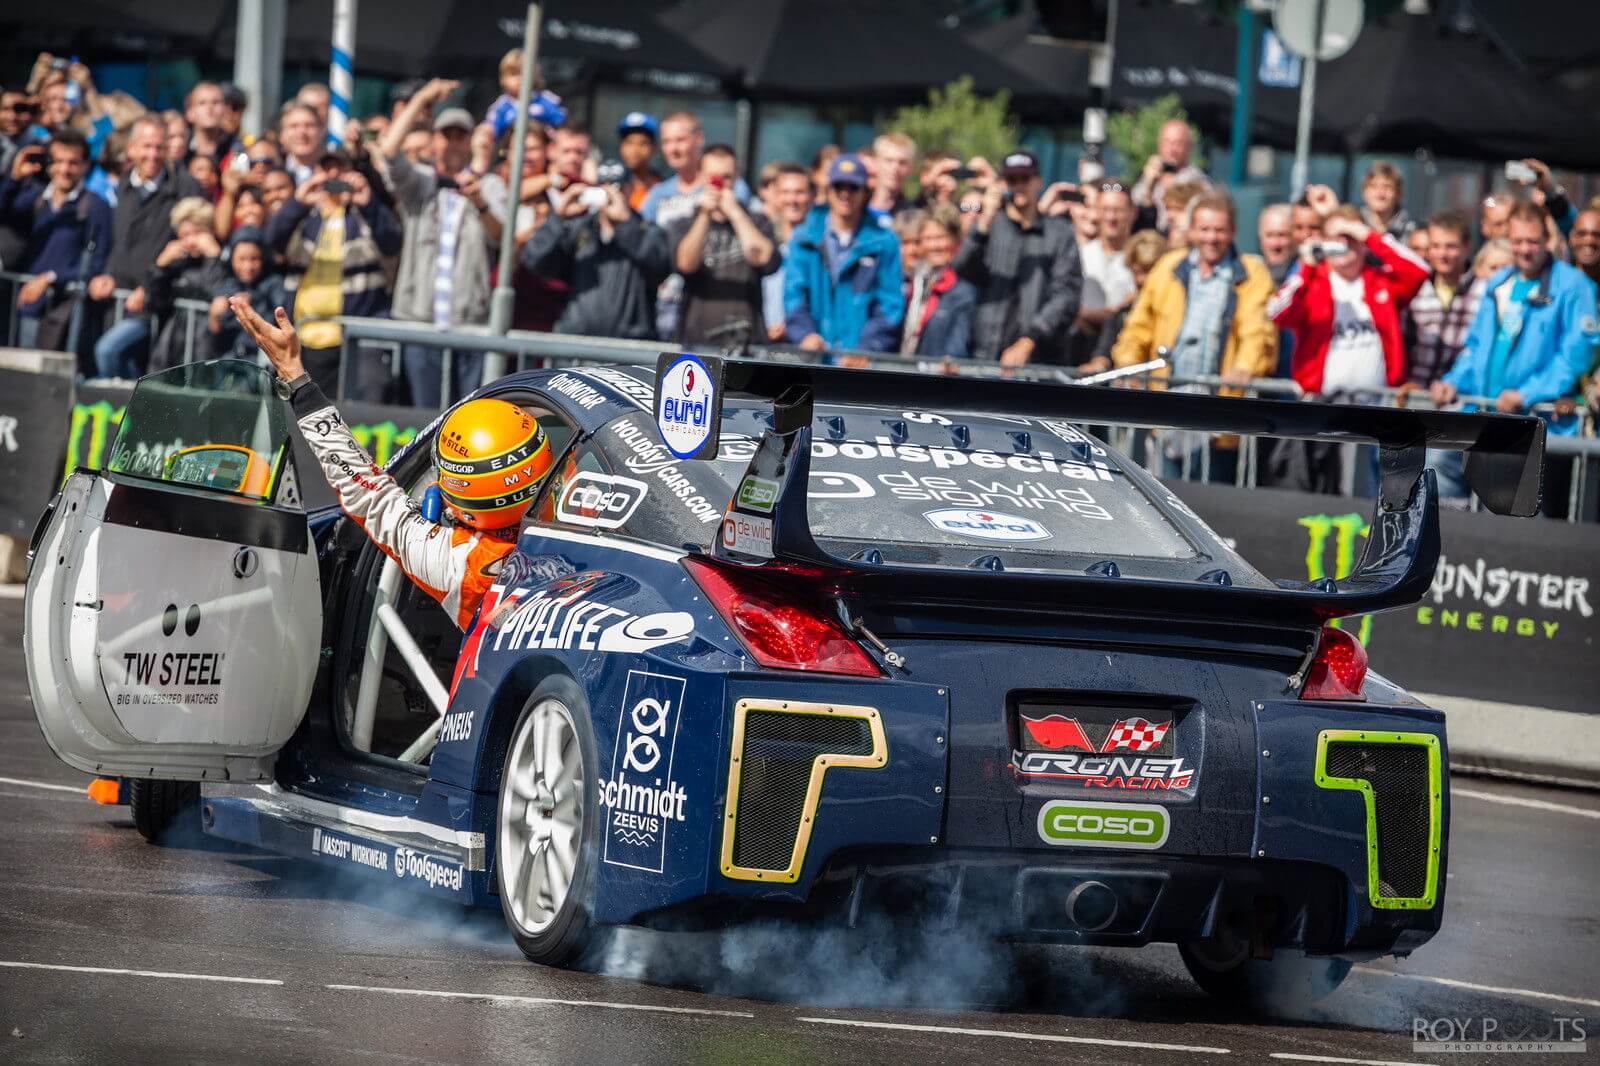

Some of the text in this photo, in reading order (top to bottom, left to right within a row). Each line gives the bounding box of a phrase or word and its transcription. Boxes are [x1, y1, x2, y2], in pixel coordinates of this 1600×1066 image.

[664, 394, 709, 427] eurol
[491, 446, 529, 470] EAT
[811, 436, 1115, 482] oolspecial
[504, 466, 533, 487] MY
[878, 470, 961, 490] de
[495, 484, 539, 507] DUS
[890, 487, 1115, 520] signing
[942, 518, 1037, 534] eurol
[1430, 555, 1594, 618] ONSTER
[1417, 606, 1560, 640] ENERGY
[124, 652, 221, 686] TW STEEL
[117, 693, 130, 705] BIG
[132, 693, 140, 705] IN
[184, 693, 219, 705] WATCHES
[440, 711, 474, 743] PNEUS
[598, 772, 687, 822] schmidt
[1084, 776, 1192, 790] RACING
[613, 811, 659, 832] ZEEVIS
